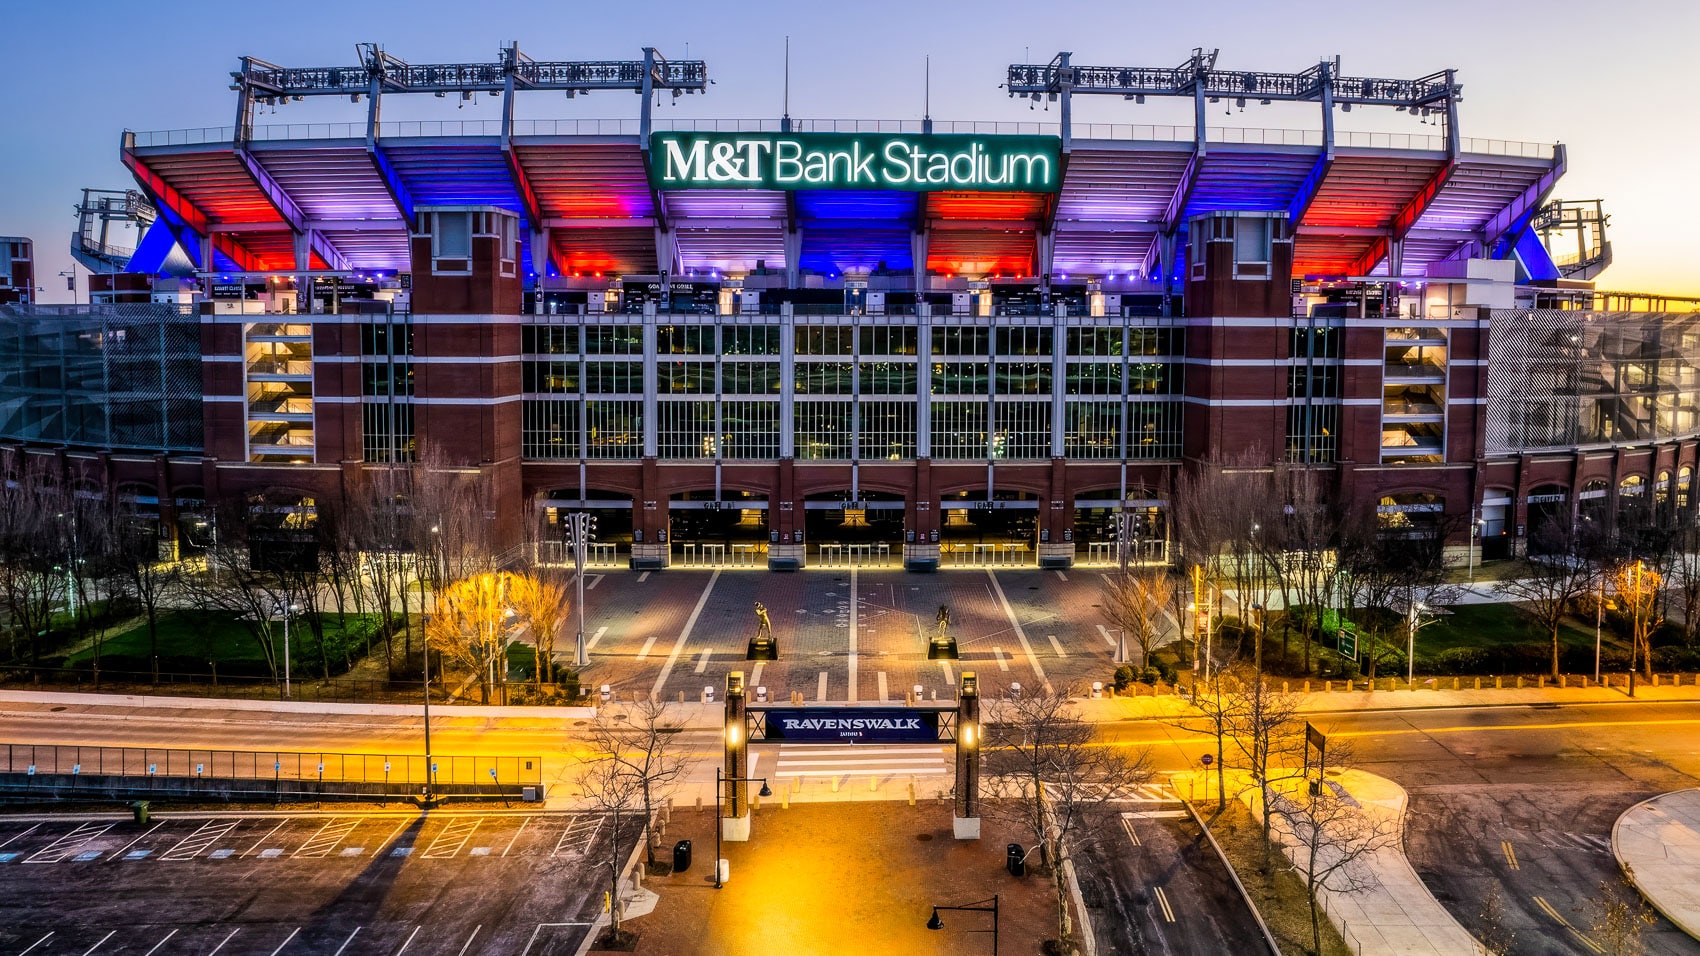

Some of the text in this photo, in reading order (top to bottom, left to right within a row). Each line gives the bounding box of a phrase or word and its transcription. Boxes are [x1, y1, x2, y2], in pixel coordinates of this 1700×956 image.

[663, 139, 1050, 184] M&T Bank Stadium
[783, 718, 921, 731] RAVENSWALK
